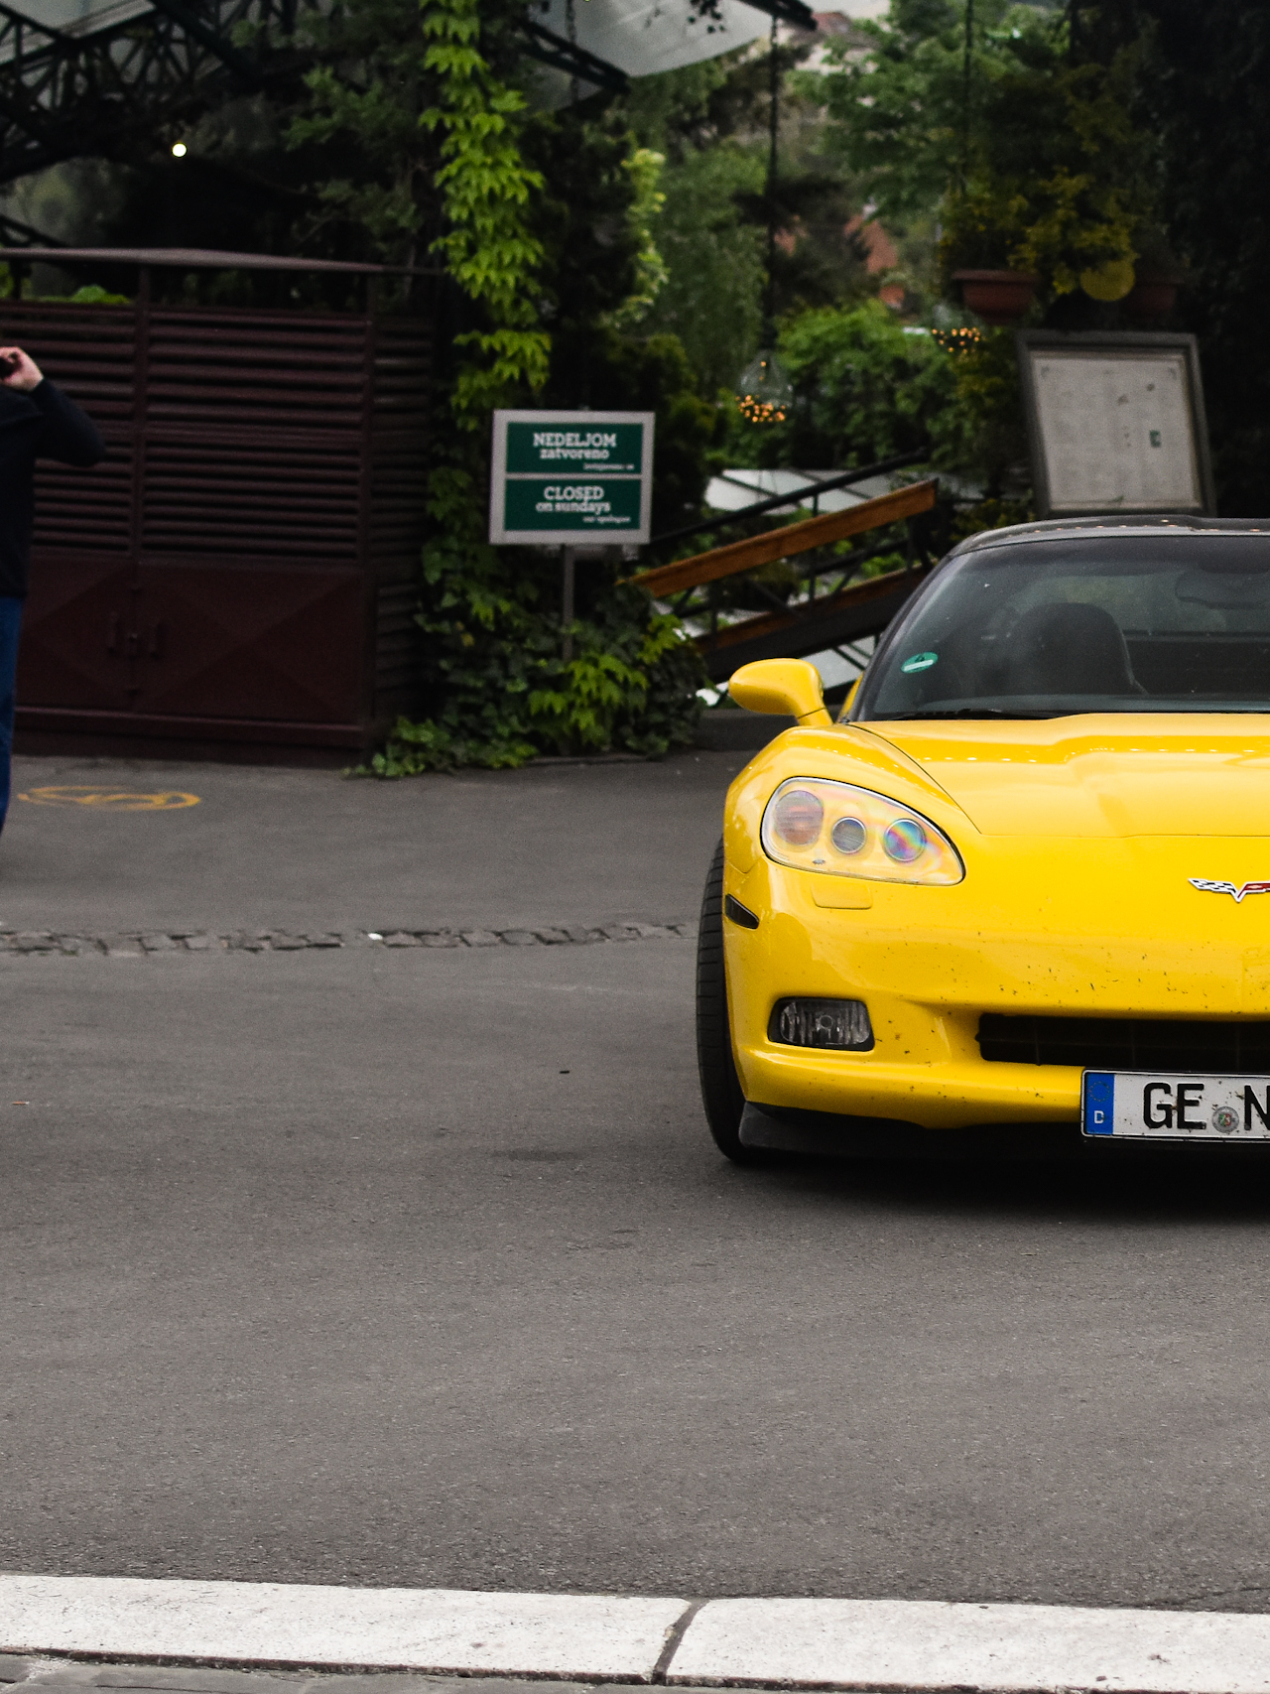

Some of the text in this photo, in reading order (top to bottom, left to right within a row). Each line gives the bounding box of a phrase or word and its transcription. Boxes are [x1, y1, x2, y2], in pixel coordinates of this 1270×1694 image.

[532, 432, 617, 447] NEDELJOM
[540, 447, 610, 459] zatvoreno
[544, 486, 604, 500] CLOSED
[535, 497, 611, 515] on sundays
[1143, 1082, 1207, 1130] GE
[1093, 1110, 1104, 1124] D
